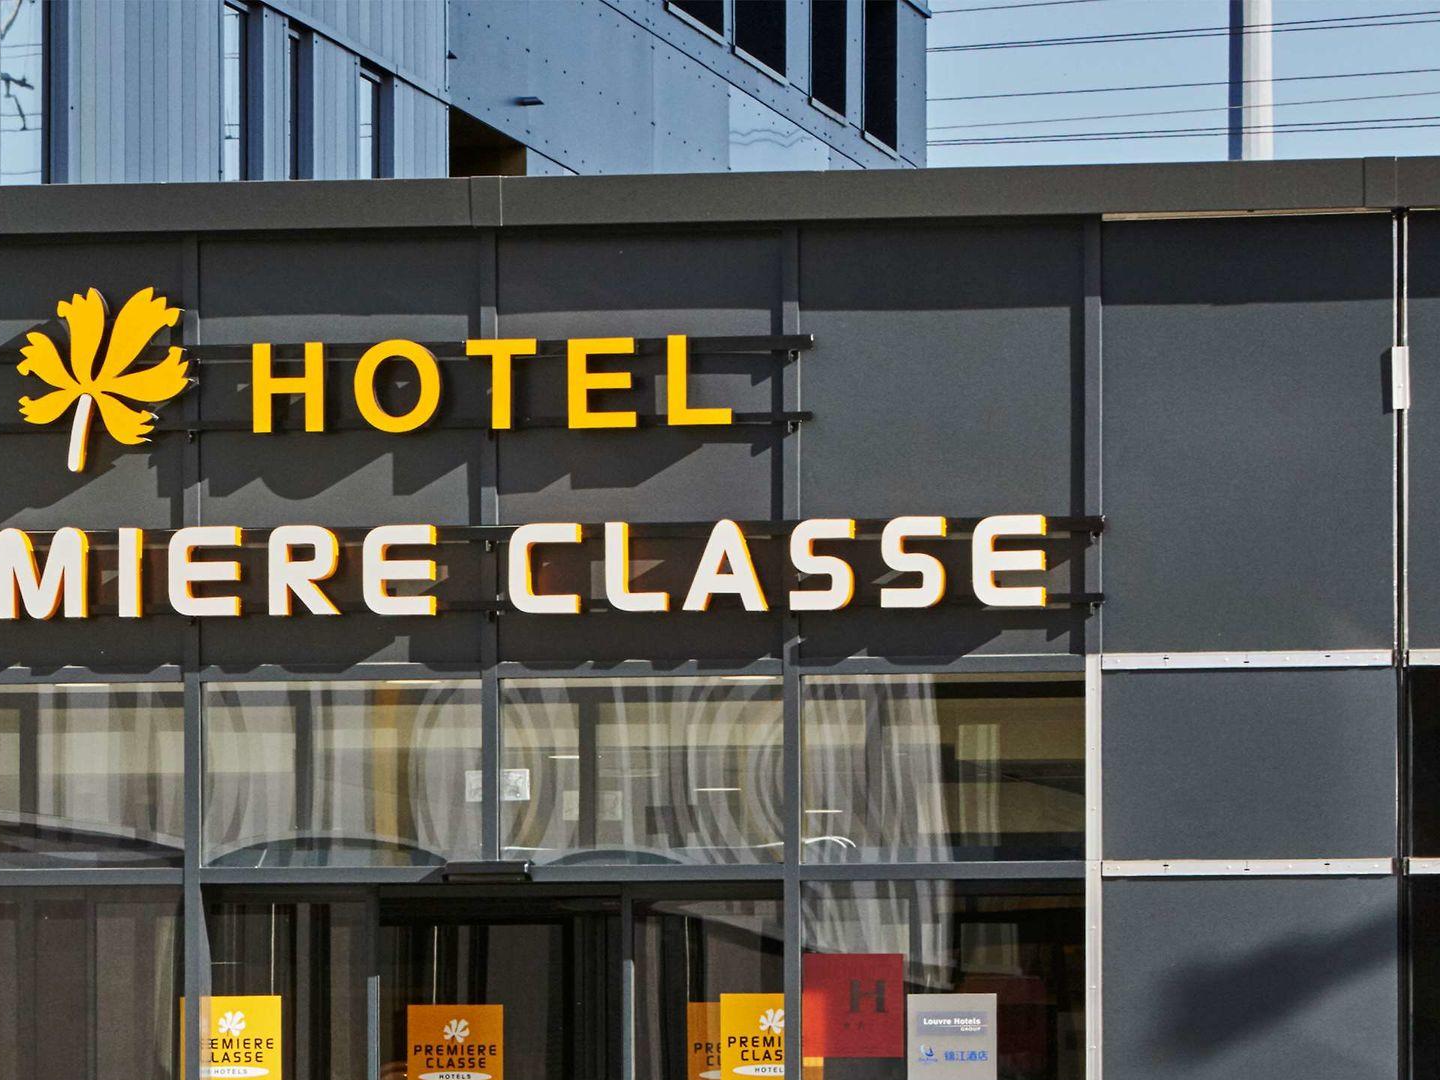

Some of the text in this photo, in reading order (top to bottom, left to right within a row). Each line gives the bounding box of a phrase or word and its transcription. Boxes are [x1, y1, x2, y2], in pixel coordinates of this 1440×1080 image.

[251, 334, 735, 434] HOTEL
[507, 514, 1050, 614] CLASSE
[923, 1017, 981, 1025] Louvre Hotels
[210, 1038, 274, 1049] EMIERE
[727, 1036, 782, 1048] PREMI
[413, 1044, 497, 1056] PREMIERE
[741, 1049, 783, 1061] CLAS
[211, 1052, 264, 1063] LASSE
[426, 1057, 486, 1069] CLASSE
